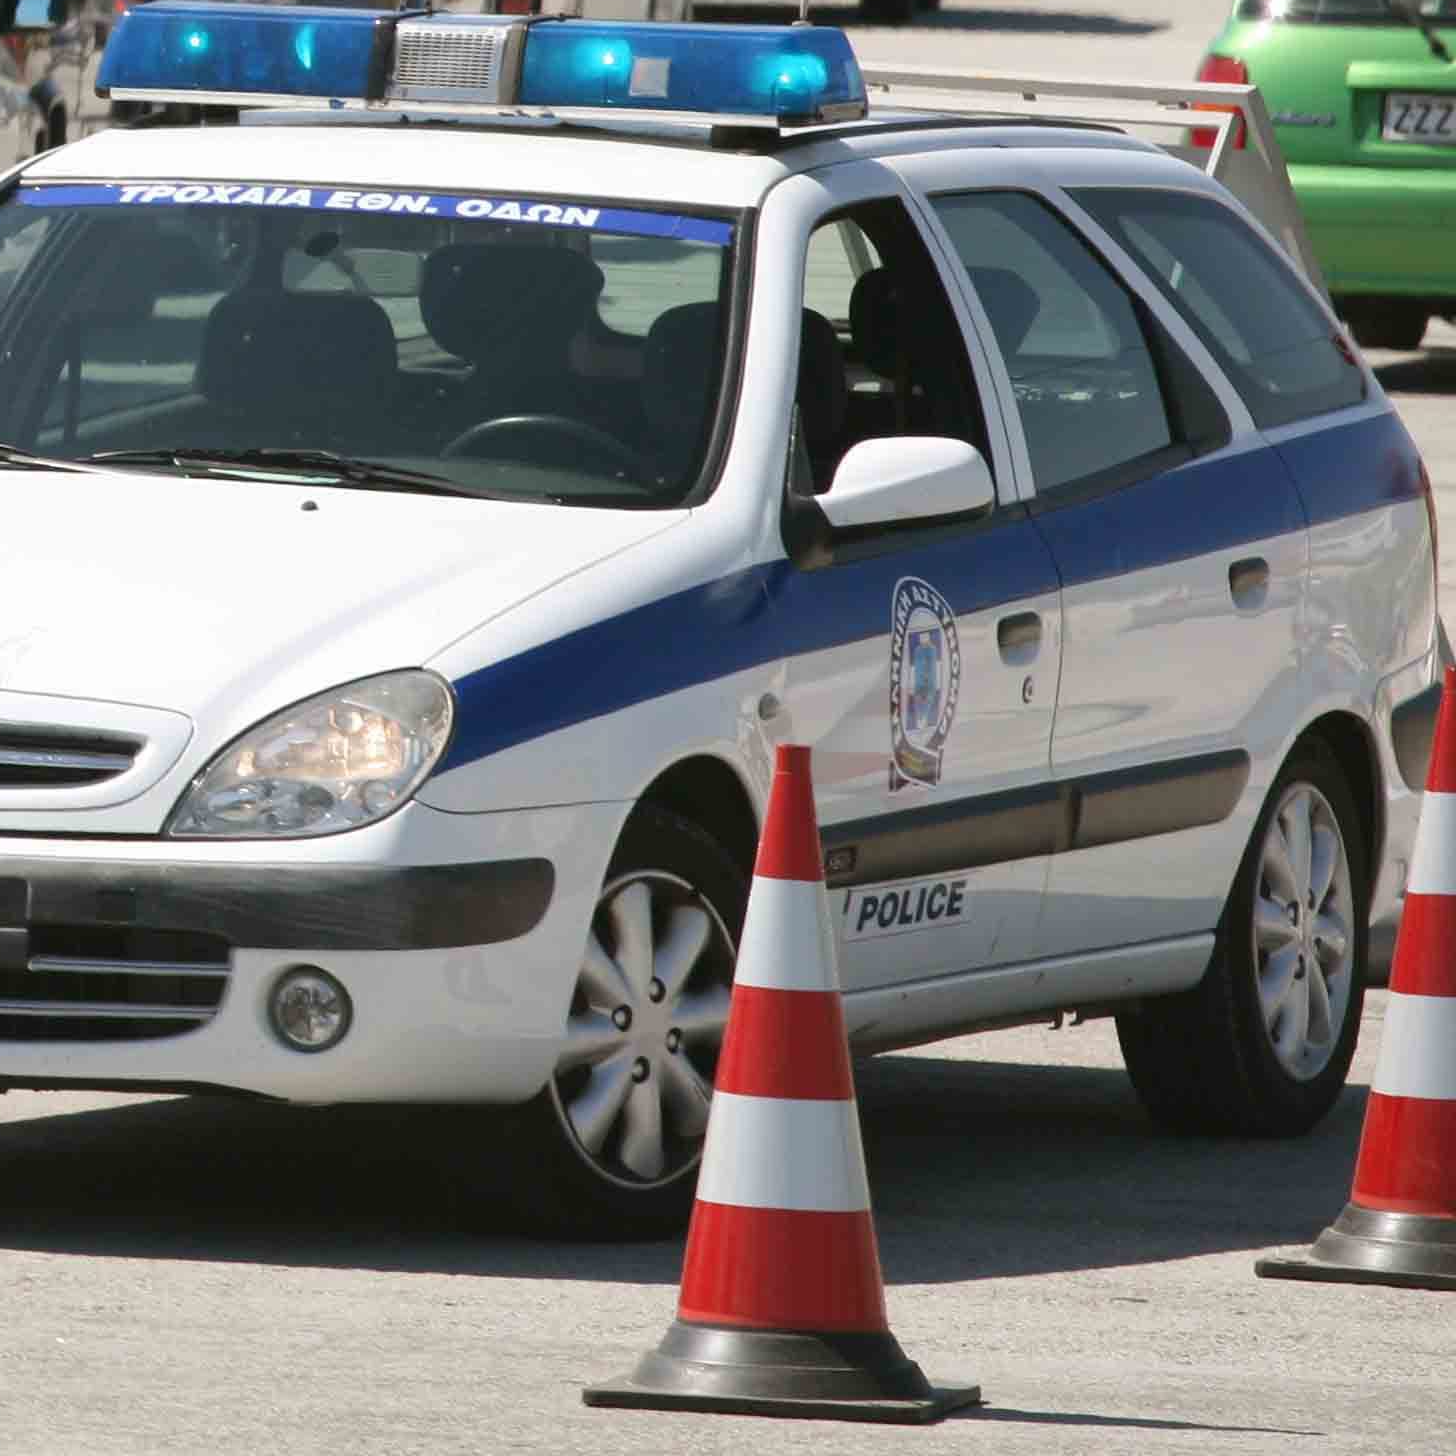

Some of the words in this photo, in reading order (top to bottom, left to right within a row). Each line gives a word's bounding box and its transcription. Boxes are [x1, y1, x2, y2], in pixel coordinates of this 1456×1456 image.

[119, 184, 312, 207] ΤΡΟΧΑΙΑ
[325, 191, 438, 214] ΕΘΝ.
[455, 199, 600, 226] ΟΔΩΝ
[856, 880, 967, 932] POLICE
